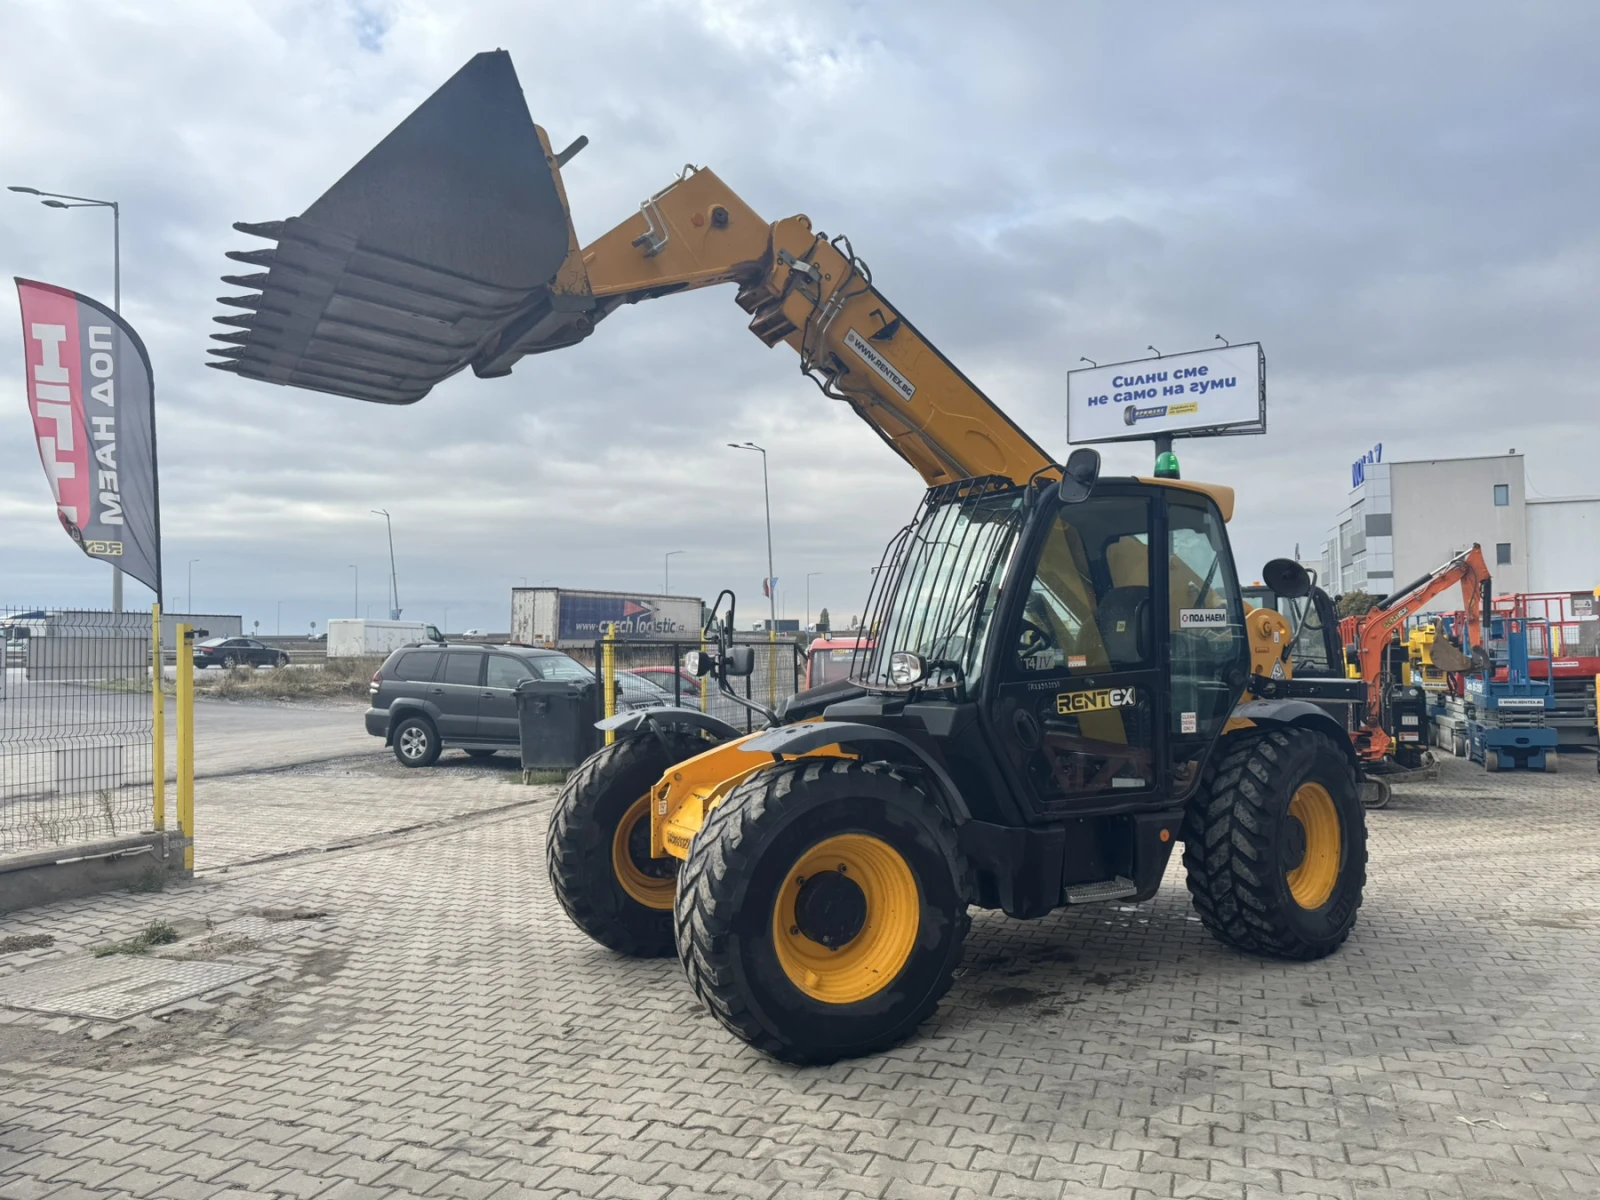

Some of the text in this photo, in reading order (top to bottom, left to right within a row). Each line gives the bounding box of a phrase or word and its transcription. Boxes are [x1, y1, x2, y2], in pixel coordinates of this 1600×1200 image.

[854, 339, 913, 396] WWW.RENTEX.BG
[1112, 365, 1209, 388] Силни сме
[1088, 376, 1237, 407] не само на гуми
[1189, 613, 1226, 622] ПОД НАЕМ
[1058, 687, 1134, 712] RENTEX
